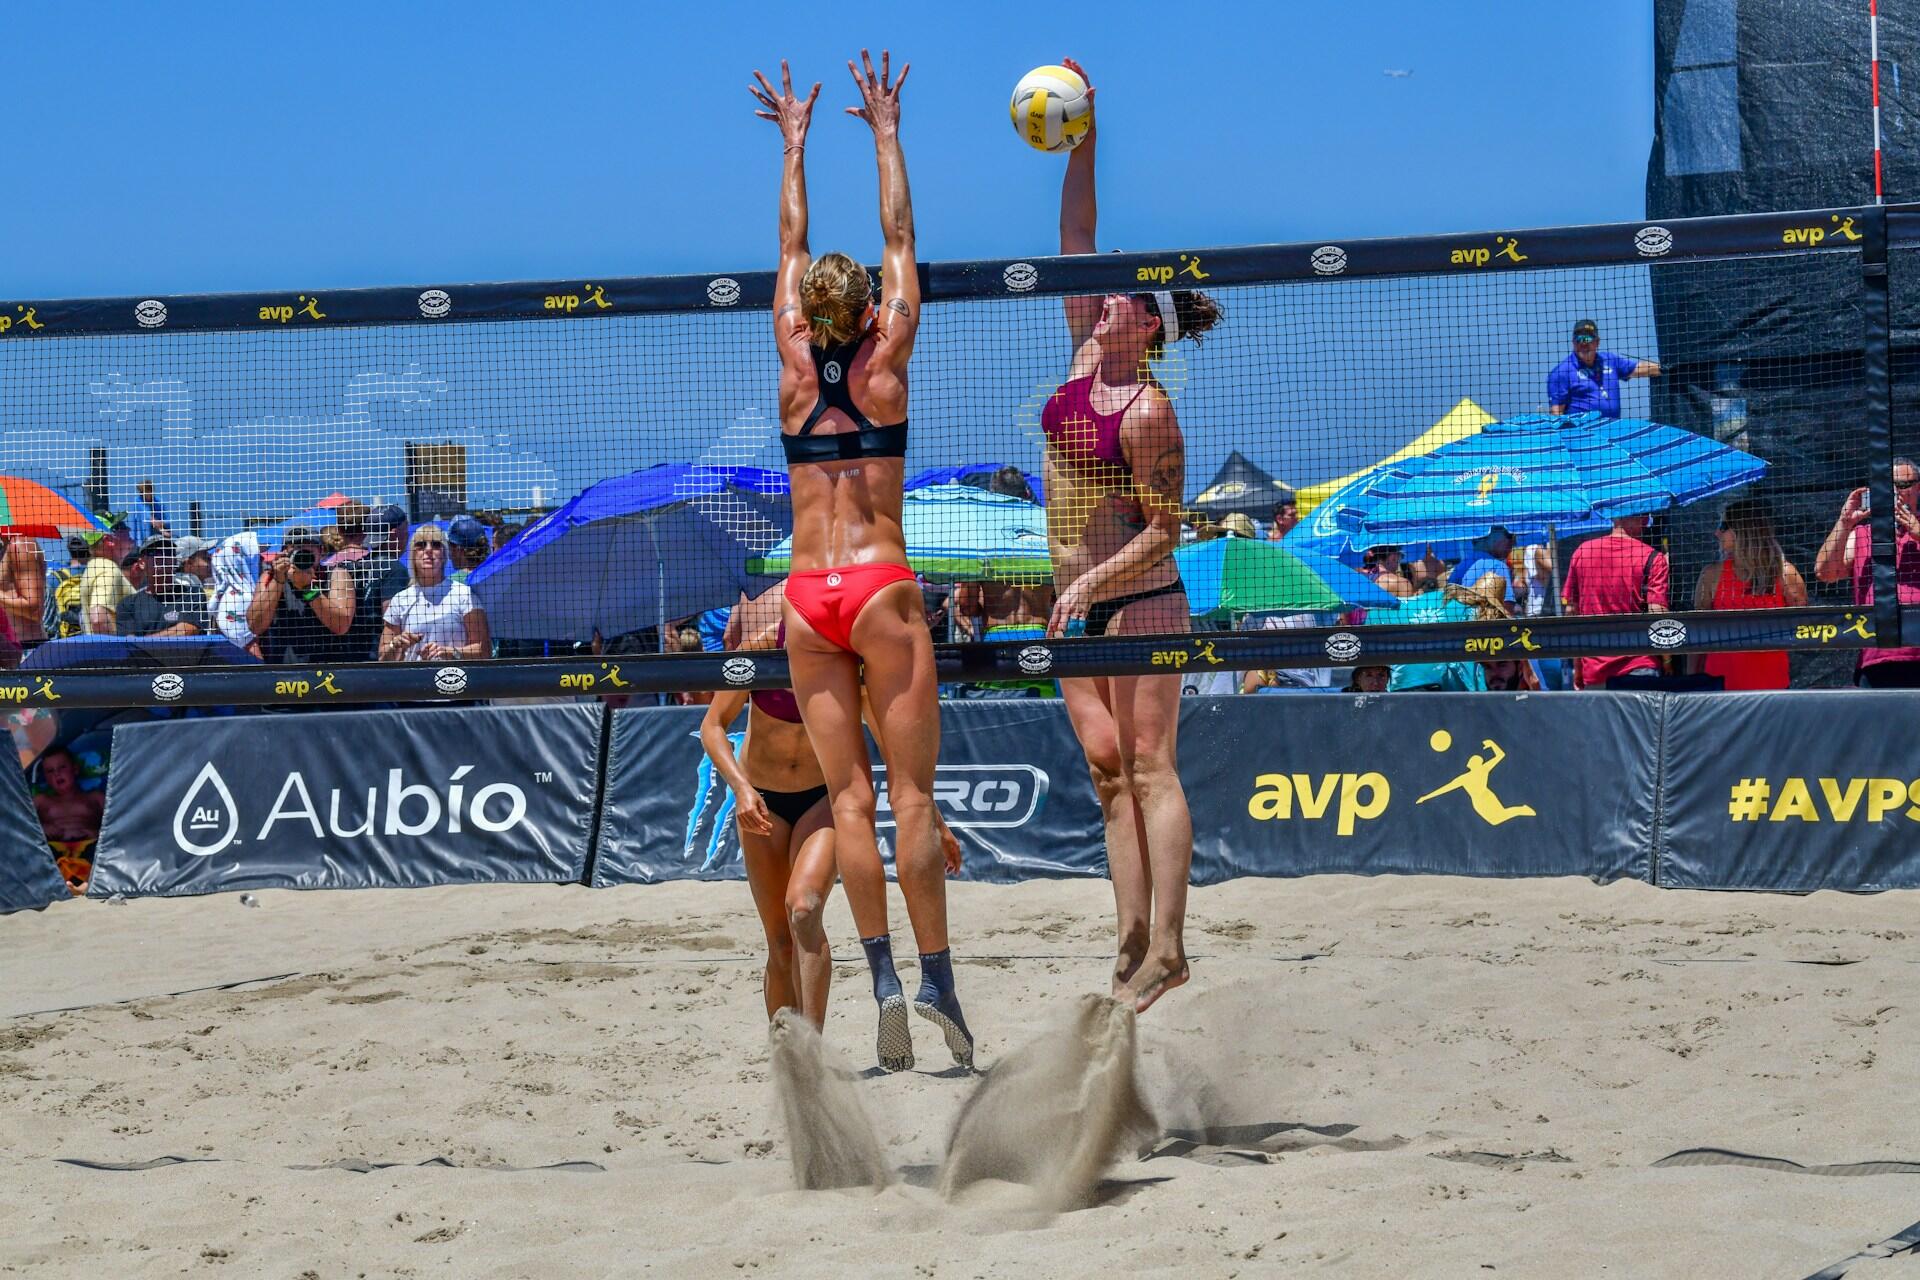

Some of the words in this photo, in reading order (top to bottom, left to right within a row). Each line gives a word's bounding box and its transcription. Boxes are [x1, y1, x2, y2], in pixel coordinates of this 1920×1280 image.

[1783, 227, 1824, 246] avp
[1451, 248, 1490, 267] avp
[1137, 266, 1174, 284] avp
[544, 295, 579, 312] avp
[260, 306, 293, 323] avp
[1796, 624, 1837, 643] avp
[1467, 637, 1504, 655] avp
[1152, 650, 1189, 668] avp
[276, 681, 309, 697] avp
[560, 673, 594, 690] avp
[1248, 772, 1391, 835] avp
[191, 806, 219, 823] Au
